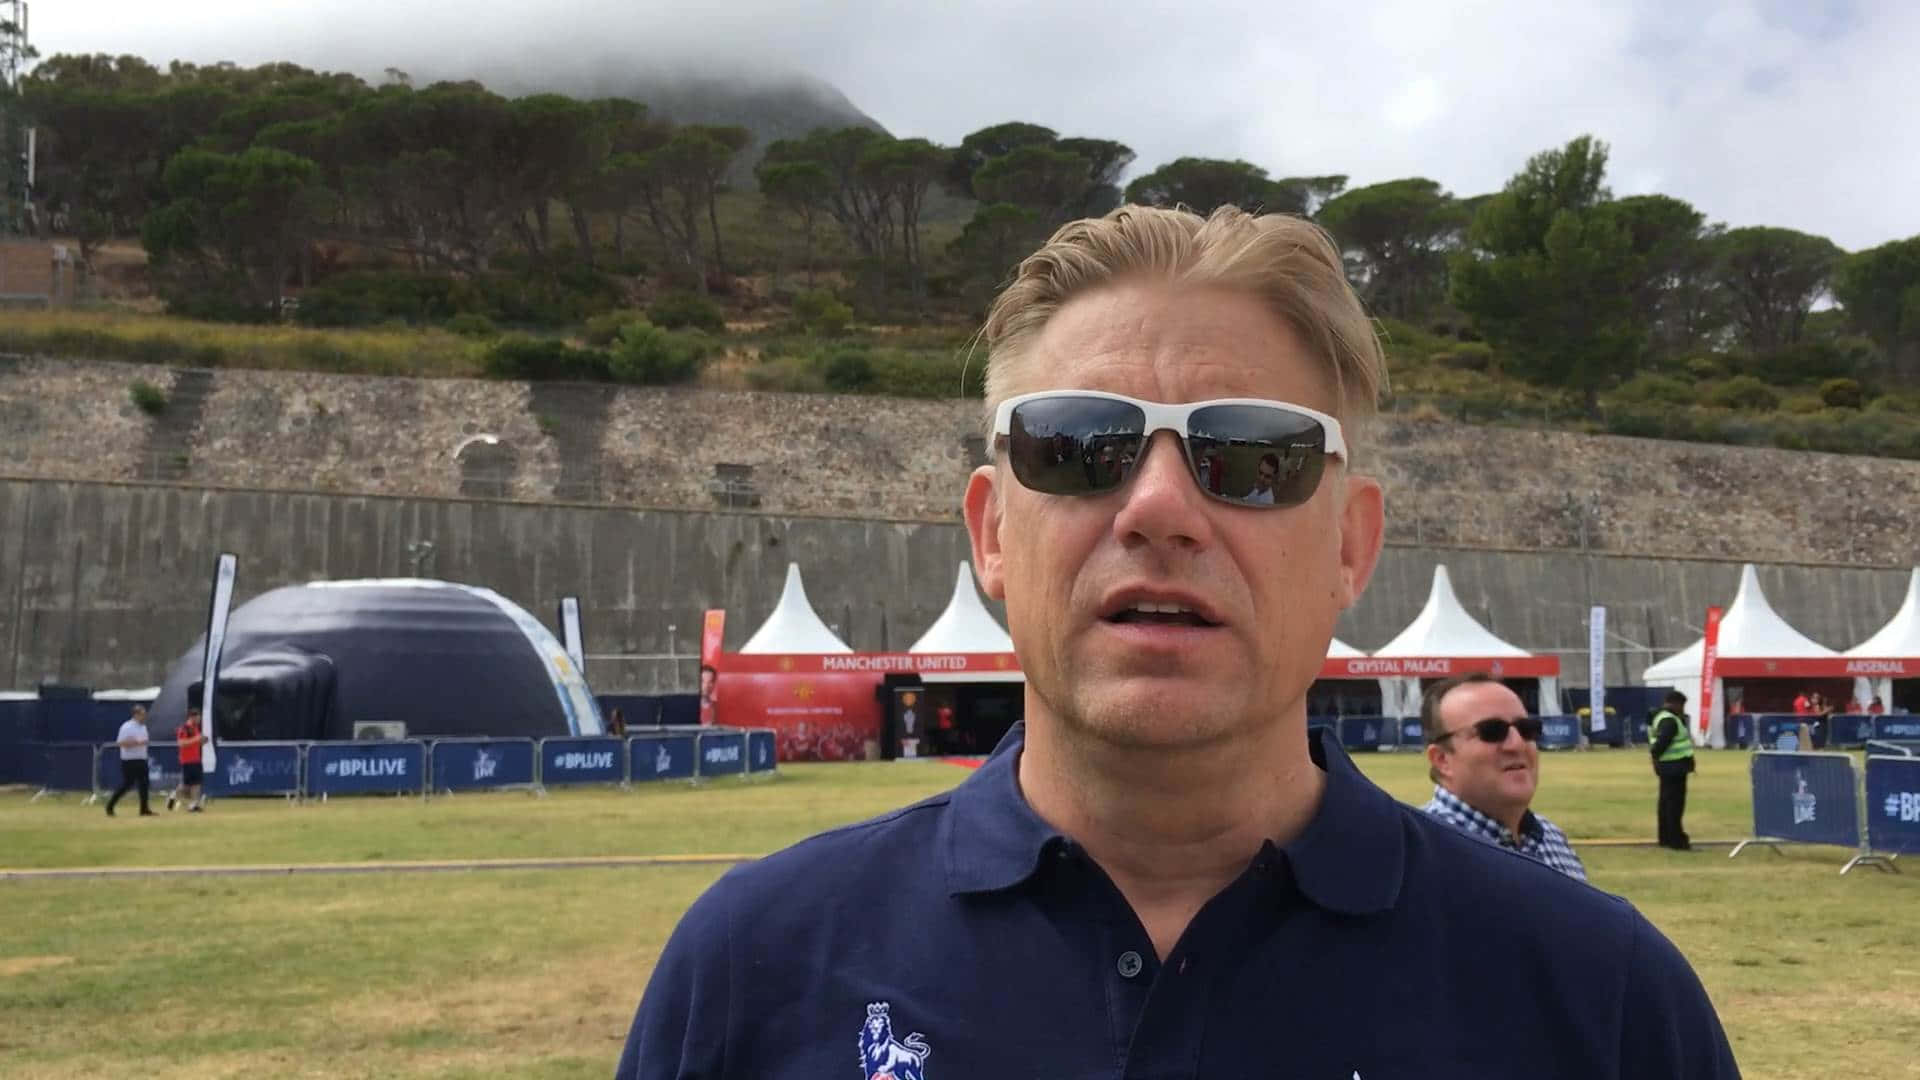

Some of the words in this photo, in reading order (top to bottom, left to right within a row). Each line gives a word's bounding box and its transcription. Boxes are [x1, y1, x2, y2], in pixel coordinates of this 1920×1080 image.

[823, 656, 912, 671] MANCHESTER
[916, 656, 967, 671] UNITED
[1347, 658, 1400, 673] CRYSTAL
[1403, 658, 1451, 673] PALACE
[1846, 660, 1904, 673] ARSENAL
[324, 757, 407, 776] #BPLLIVE
[554, 751, 614, 769] #BPLLIVE
